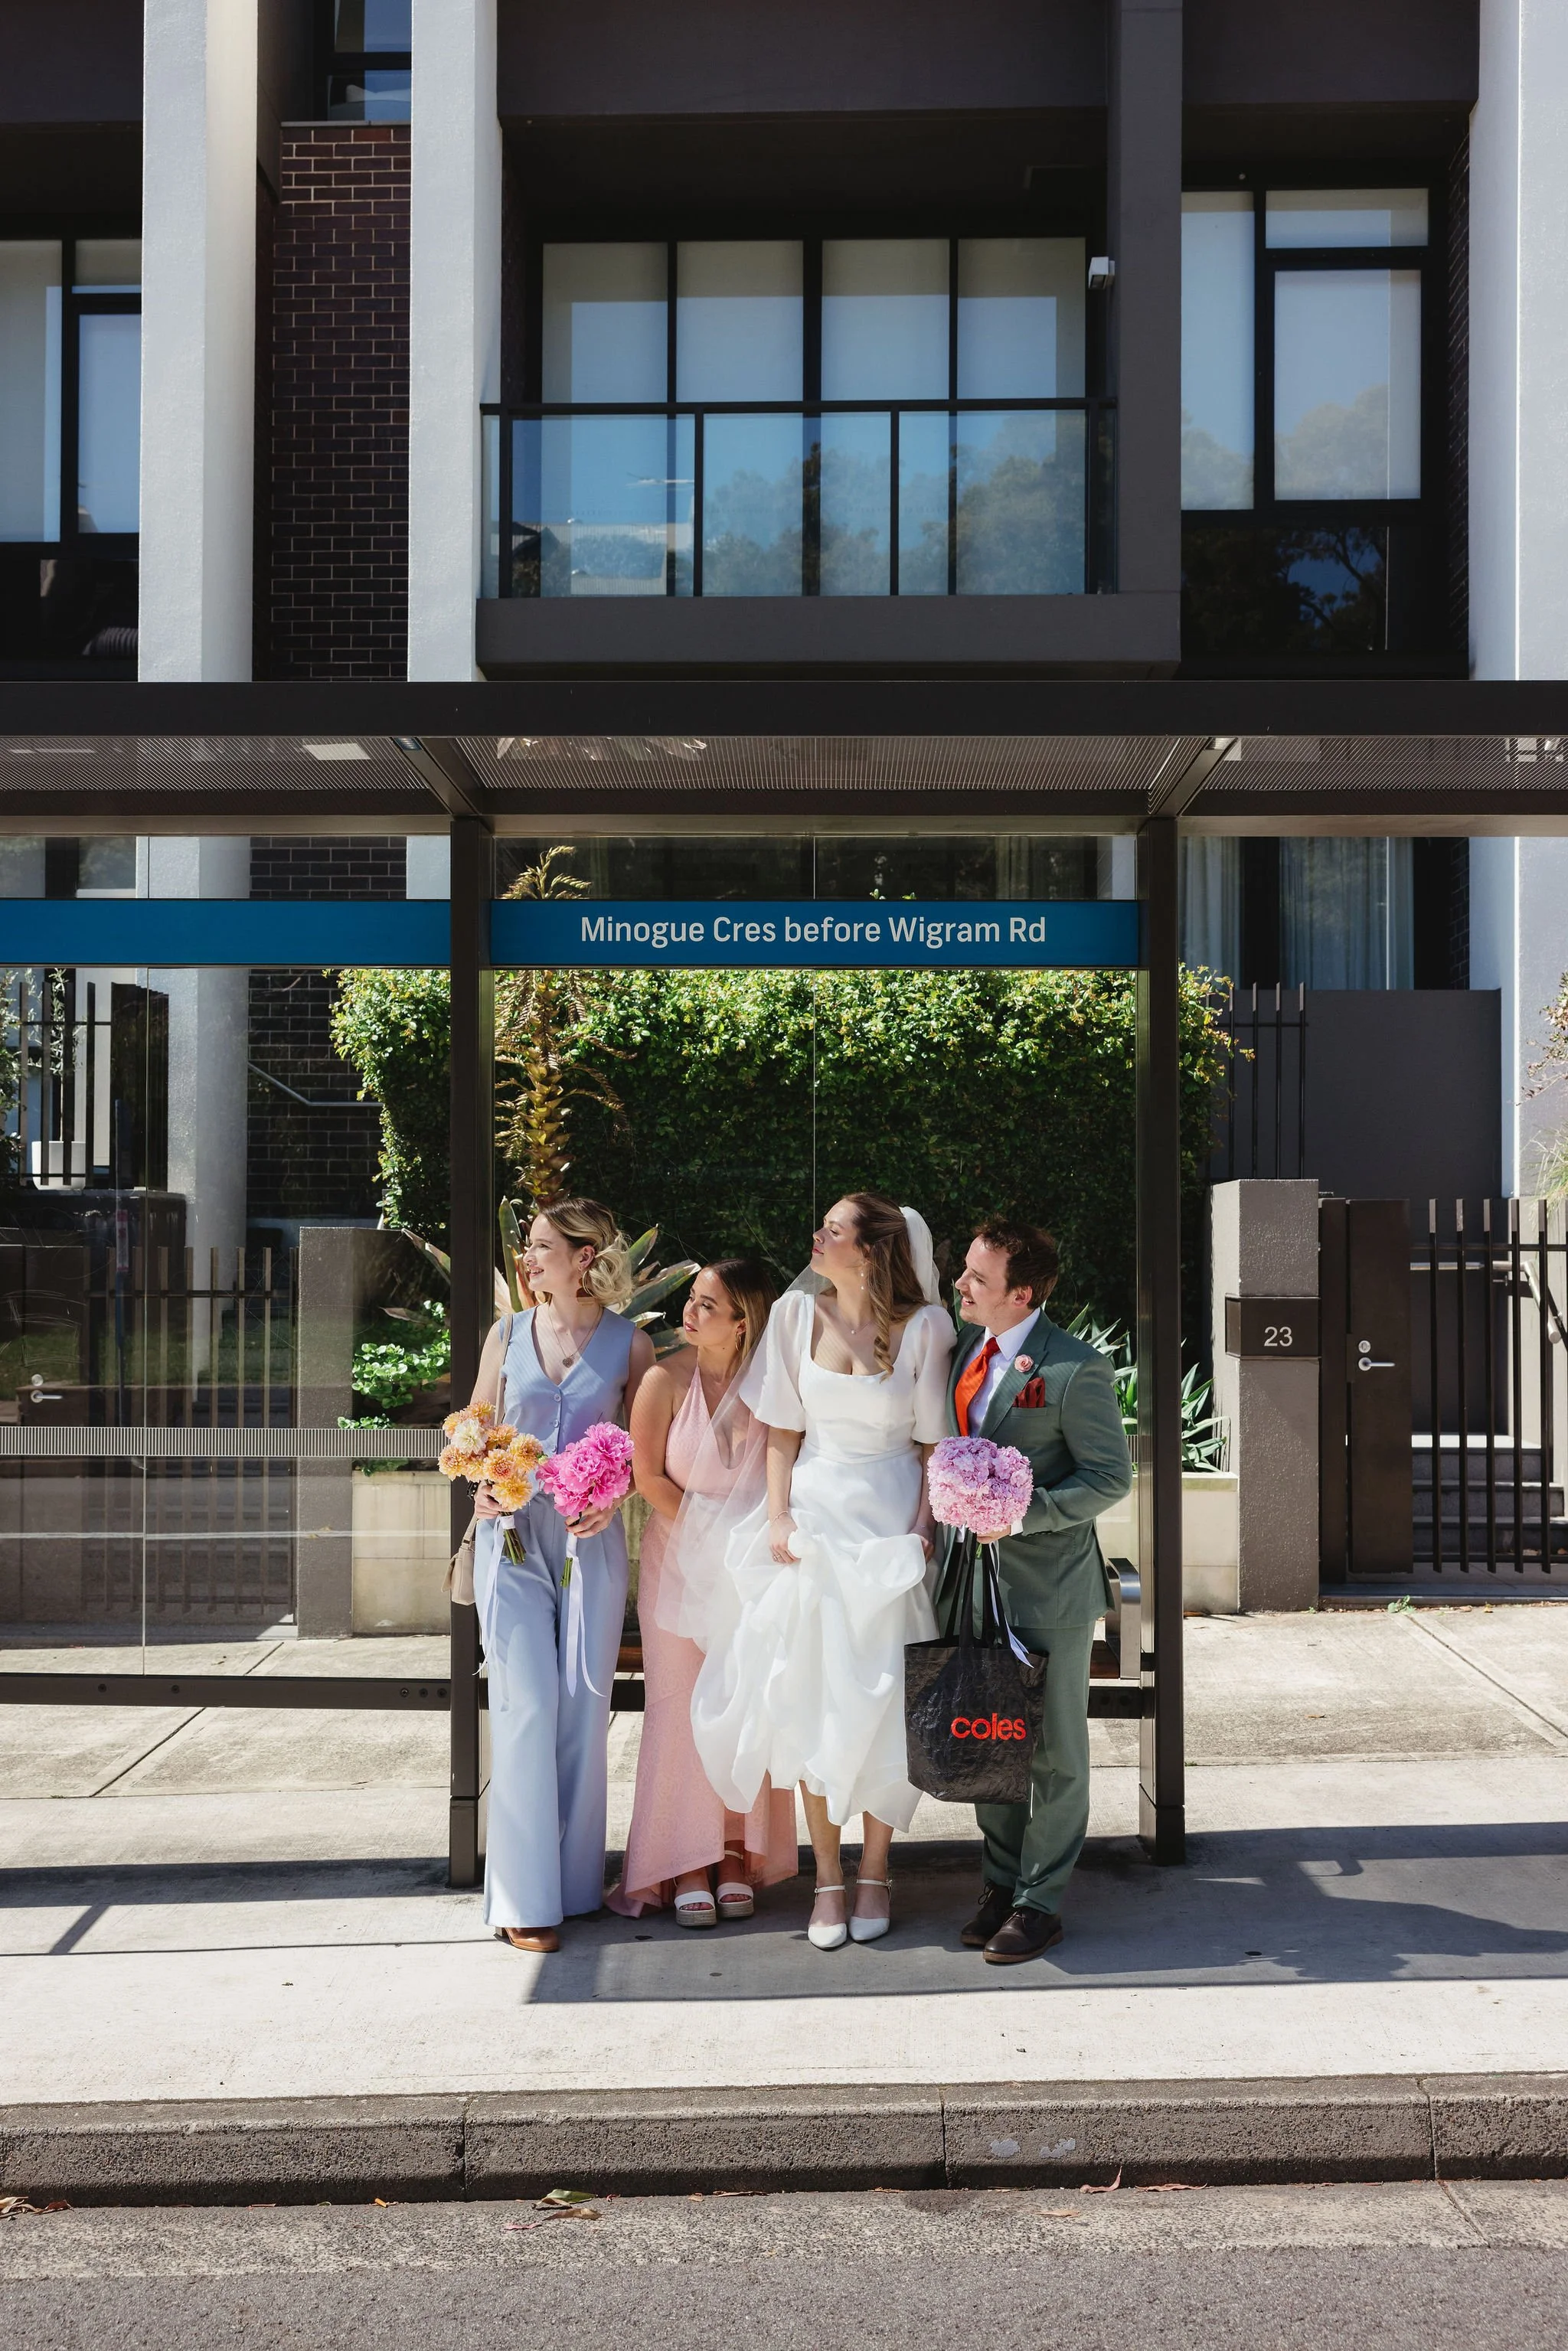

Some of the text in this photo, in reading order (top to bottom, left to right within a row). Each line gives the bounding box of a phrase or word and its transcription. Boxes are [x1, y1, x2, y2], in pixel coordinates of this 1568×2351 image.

[581, 916, 1045, 949] Minogue Cres before Wigram Rd
[1264, 1326, 1293, 1347] 23
[950, 1713, 1027, 1740] coles
